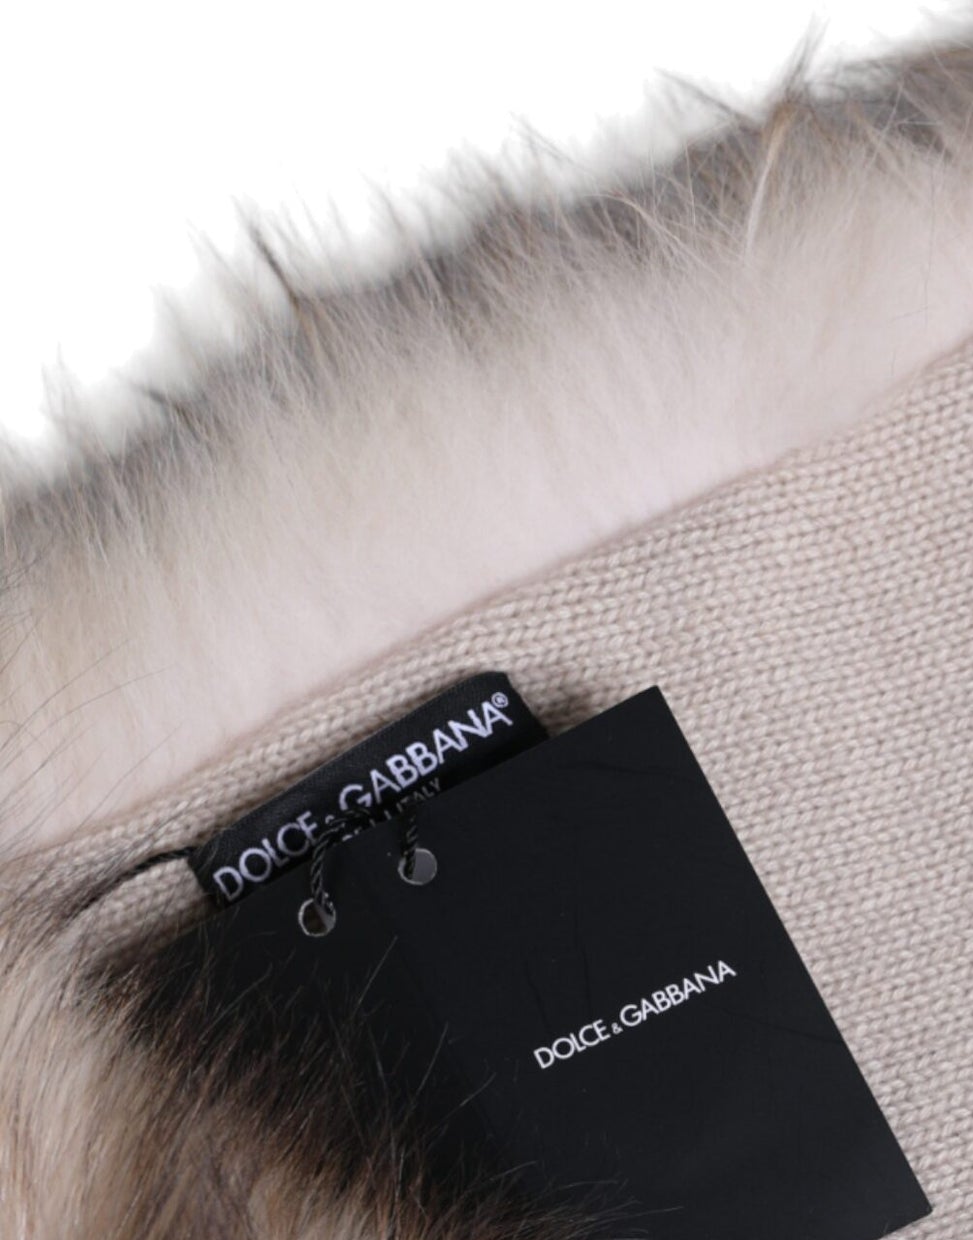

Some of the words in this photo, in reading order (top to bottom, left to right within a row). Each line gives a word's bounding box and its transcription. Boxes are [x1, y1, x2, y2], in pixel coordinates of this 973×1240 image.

[212, 811, 319, 901] DOLCE
[533, 1019, 611, 1069] DOLCE
[611, 1022, 624, 1035] &
[619, 960, 737, 1027] GABBANA
